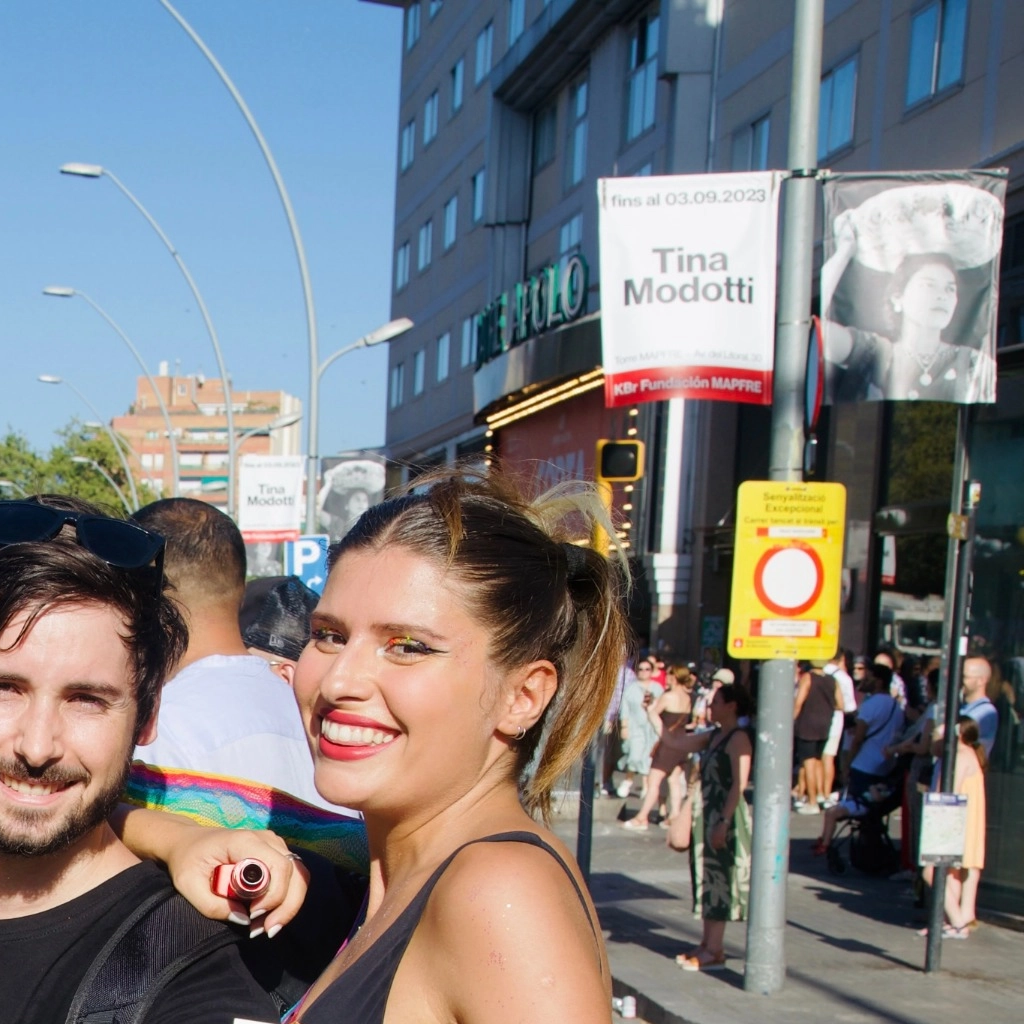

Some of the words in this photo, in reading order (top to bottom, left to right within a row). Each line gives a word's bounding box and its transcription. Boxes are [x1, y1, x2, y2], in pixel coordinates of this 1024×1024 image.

[612, 191, 642, 208] fins
[647, 192, 661, 207] al
[665, 188, 766, 206] 03.09.2023
[652, 246, 728, 273] Tina
[623, 276, 754, 306] Modotti
[613, 382, 639, 396] KBr
[640, 375, 709, 392] Fundación
[711, 376, 763, 394] MAPFRE
[258, 483, 286, 495] Tina
[247, 496, 296, 507] Modotti
[765, 503, 823, 514] Excepcional
[293, 540, 321, 576] P
